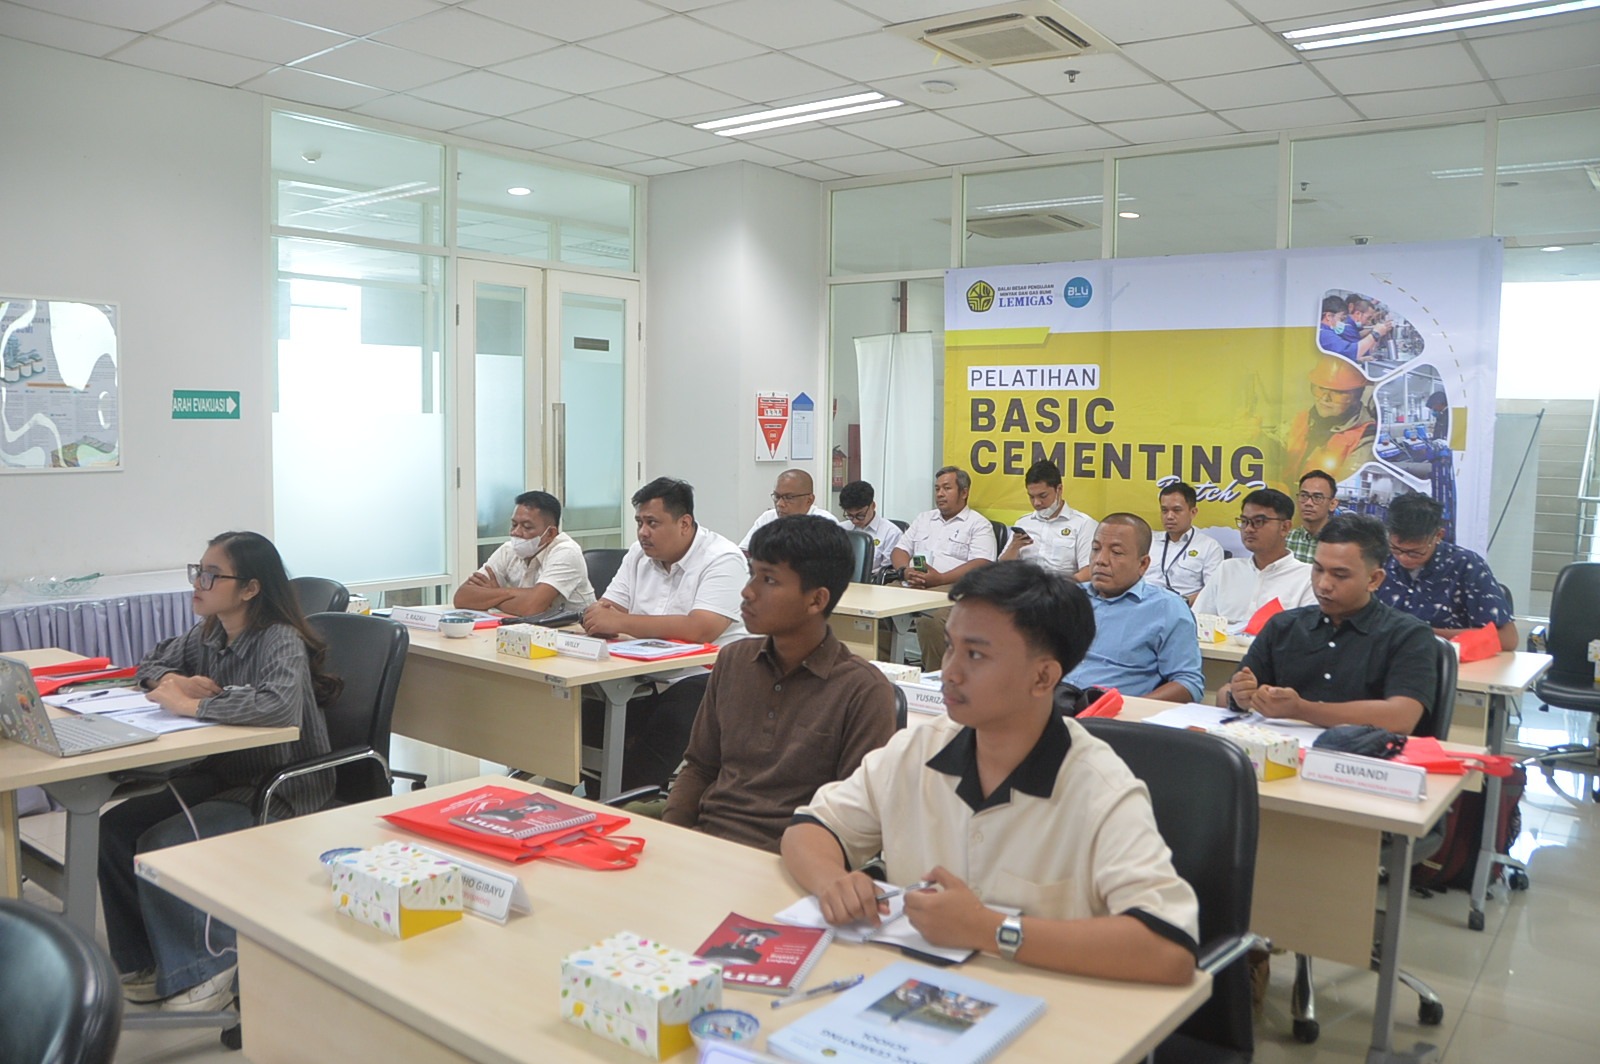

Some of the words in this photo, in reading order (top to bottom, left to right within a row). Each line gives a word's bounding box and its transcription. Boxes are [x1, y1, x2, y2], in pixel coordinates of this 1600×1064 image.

[998, 295, 1054, 308] LEMIGAS
[970, 367, 1097, 387] PELATIHAN
[173, 398, 192, 412] ARAH
[193, 398, 226, 412] EVAKUASI
[970, 397, 1115, 435] BASIC
[969, 439, 1265, 485] CEMENTING
[1156, 475, 1242, 503] tch
[915, 693, 946, 705] YUSRIZA
[1334, 762, 1389, 781] ELWANDI
[475, 880, 505, 898] GIBAYU
[722, 970, 783, 987] fan
